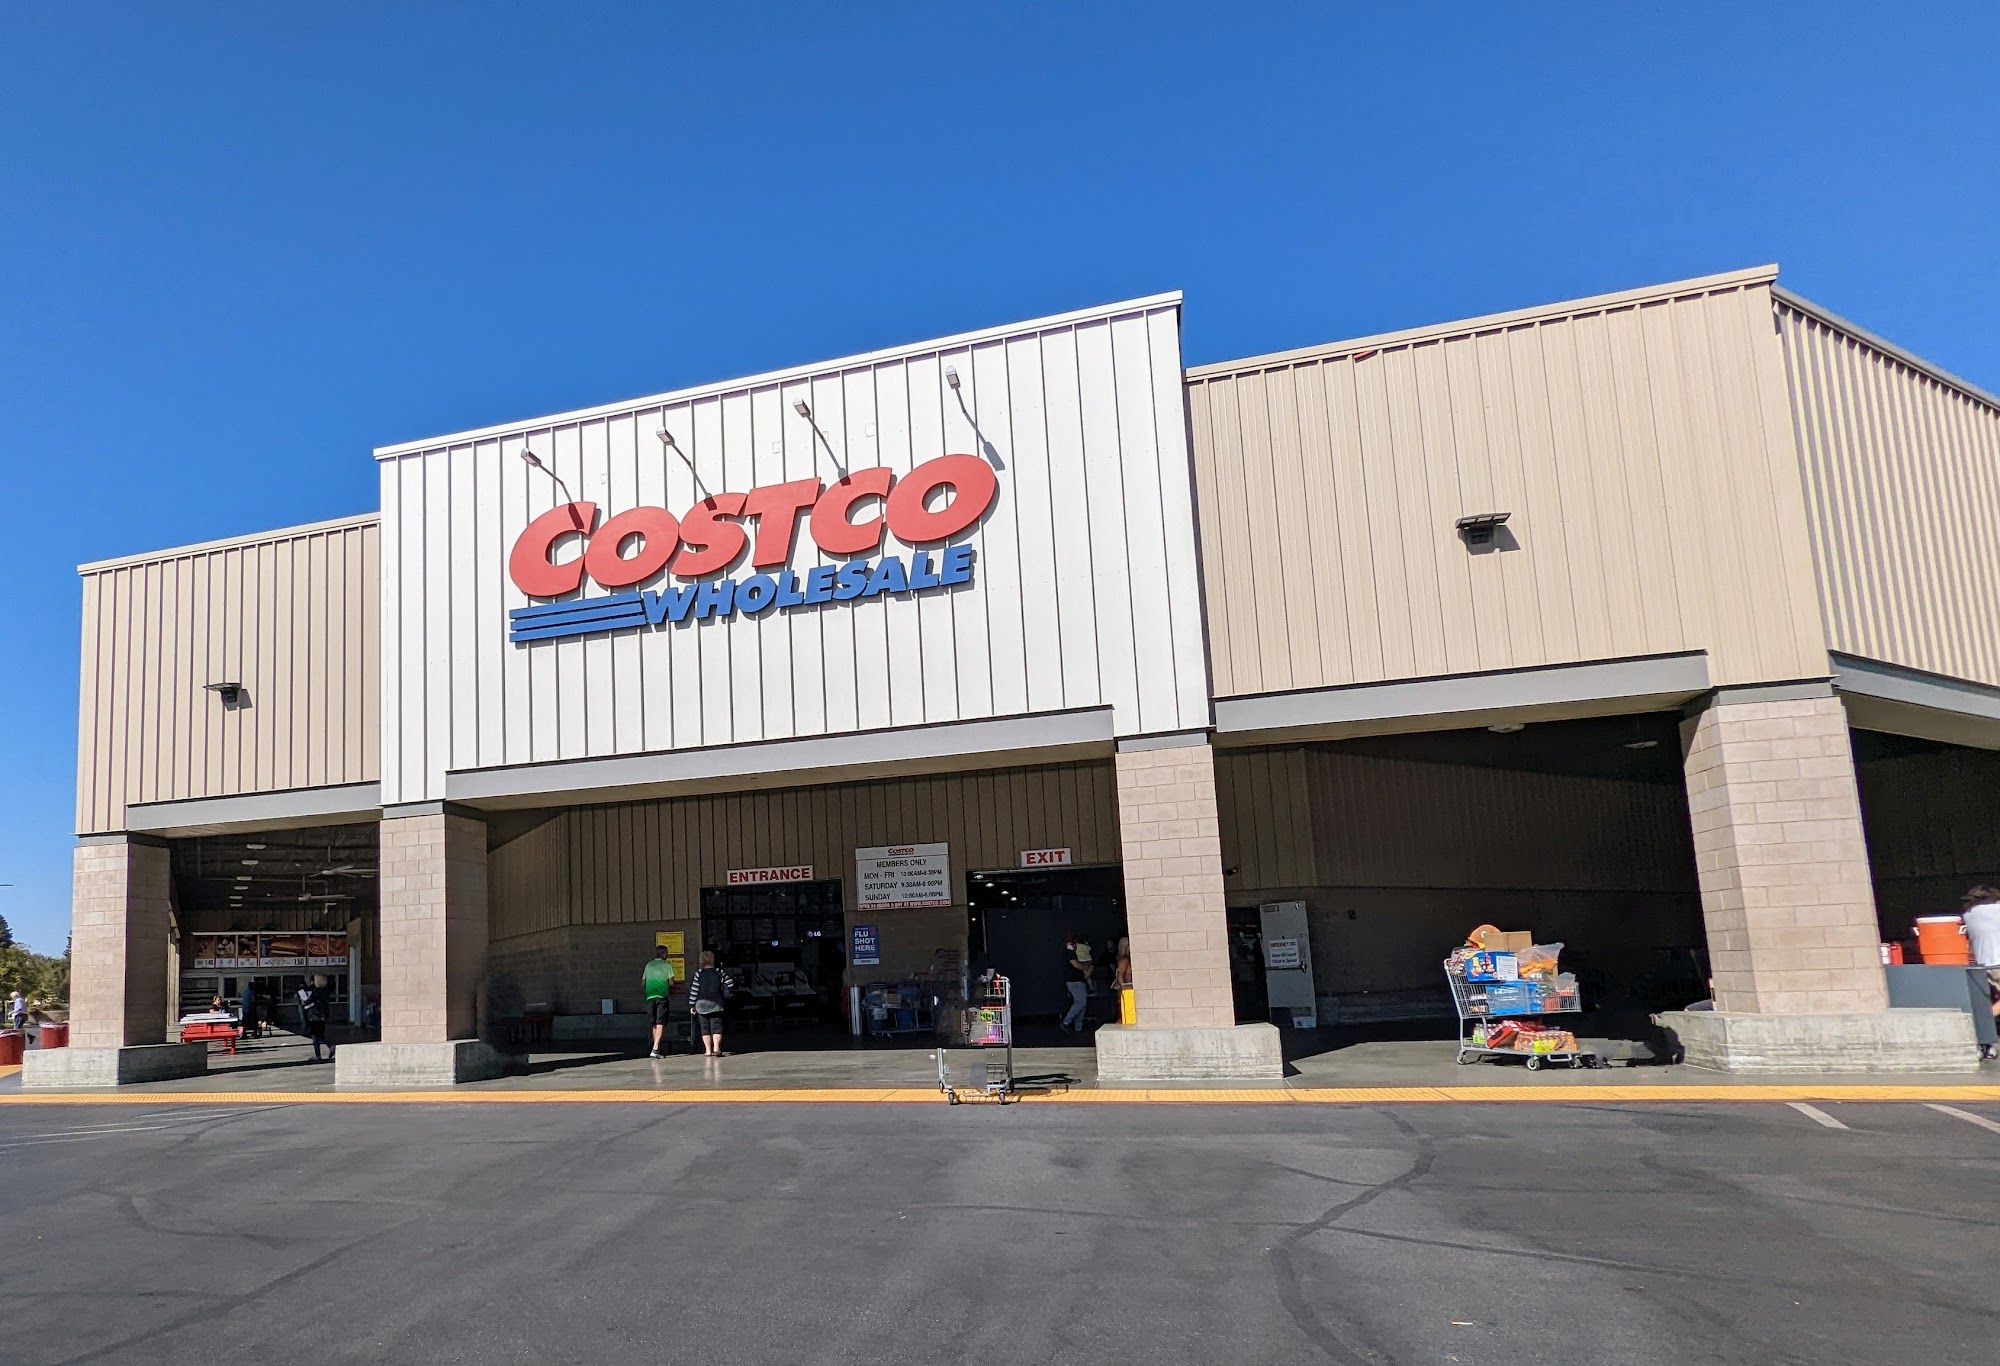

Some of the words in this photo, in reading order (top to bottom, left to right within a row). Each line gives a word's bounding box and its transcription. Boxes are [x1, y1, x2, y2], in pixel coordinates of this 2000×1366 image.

[508, 454, 997, 597] COSTCO
[642, 543, 973, 625] WHOLESALE
[1026, 851, 1065, 864] EXIT
[876, 860, 908, 868] MEMBERS
[729, 868, 811, 883] ENTRANCE
[884, 871, 895, 879] FRI
[864, 882, 897, 890] SATURDAY
[865, 893, 891, 901] SUNDAY
[854, 937, 876, 945] SHOT
